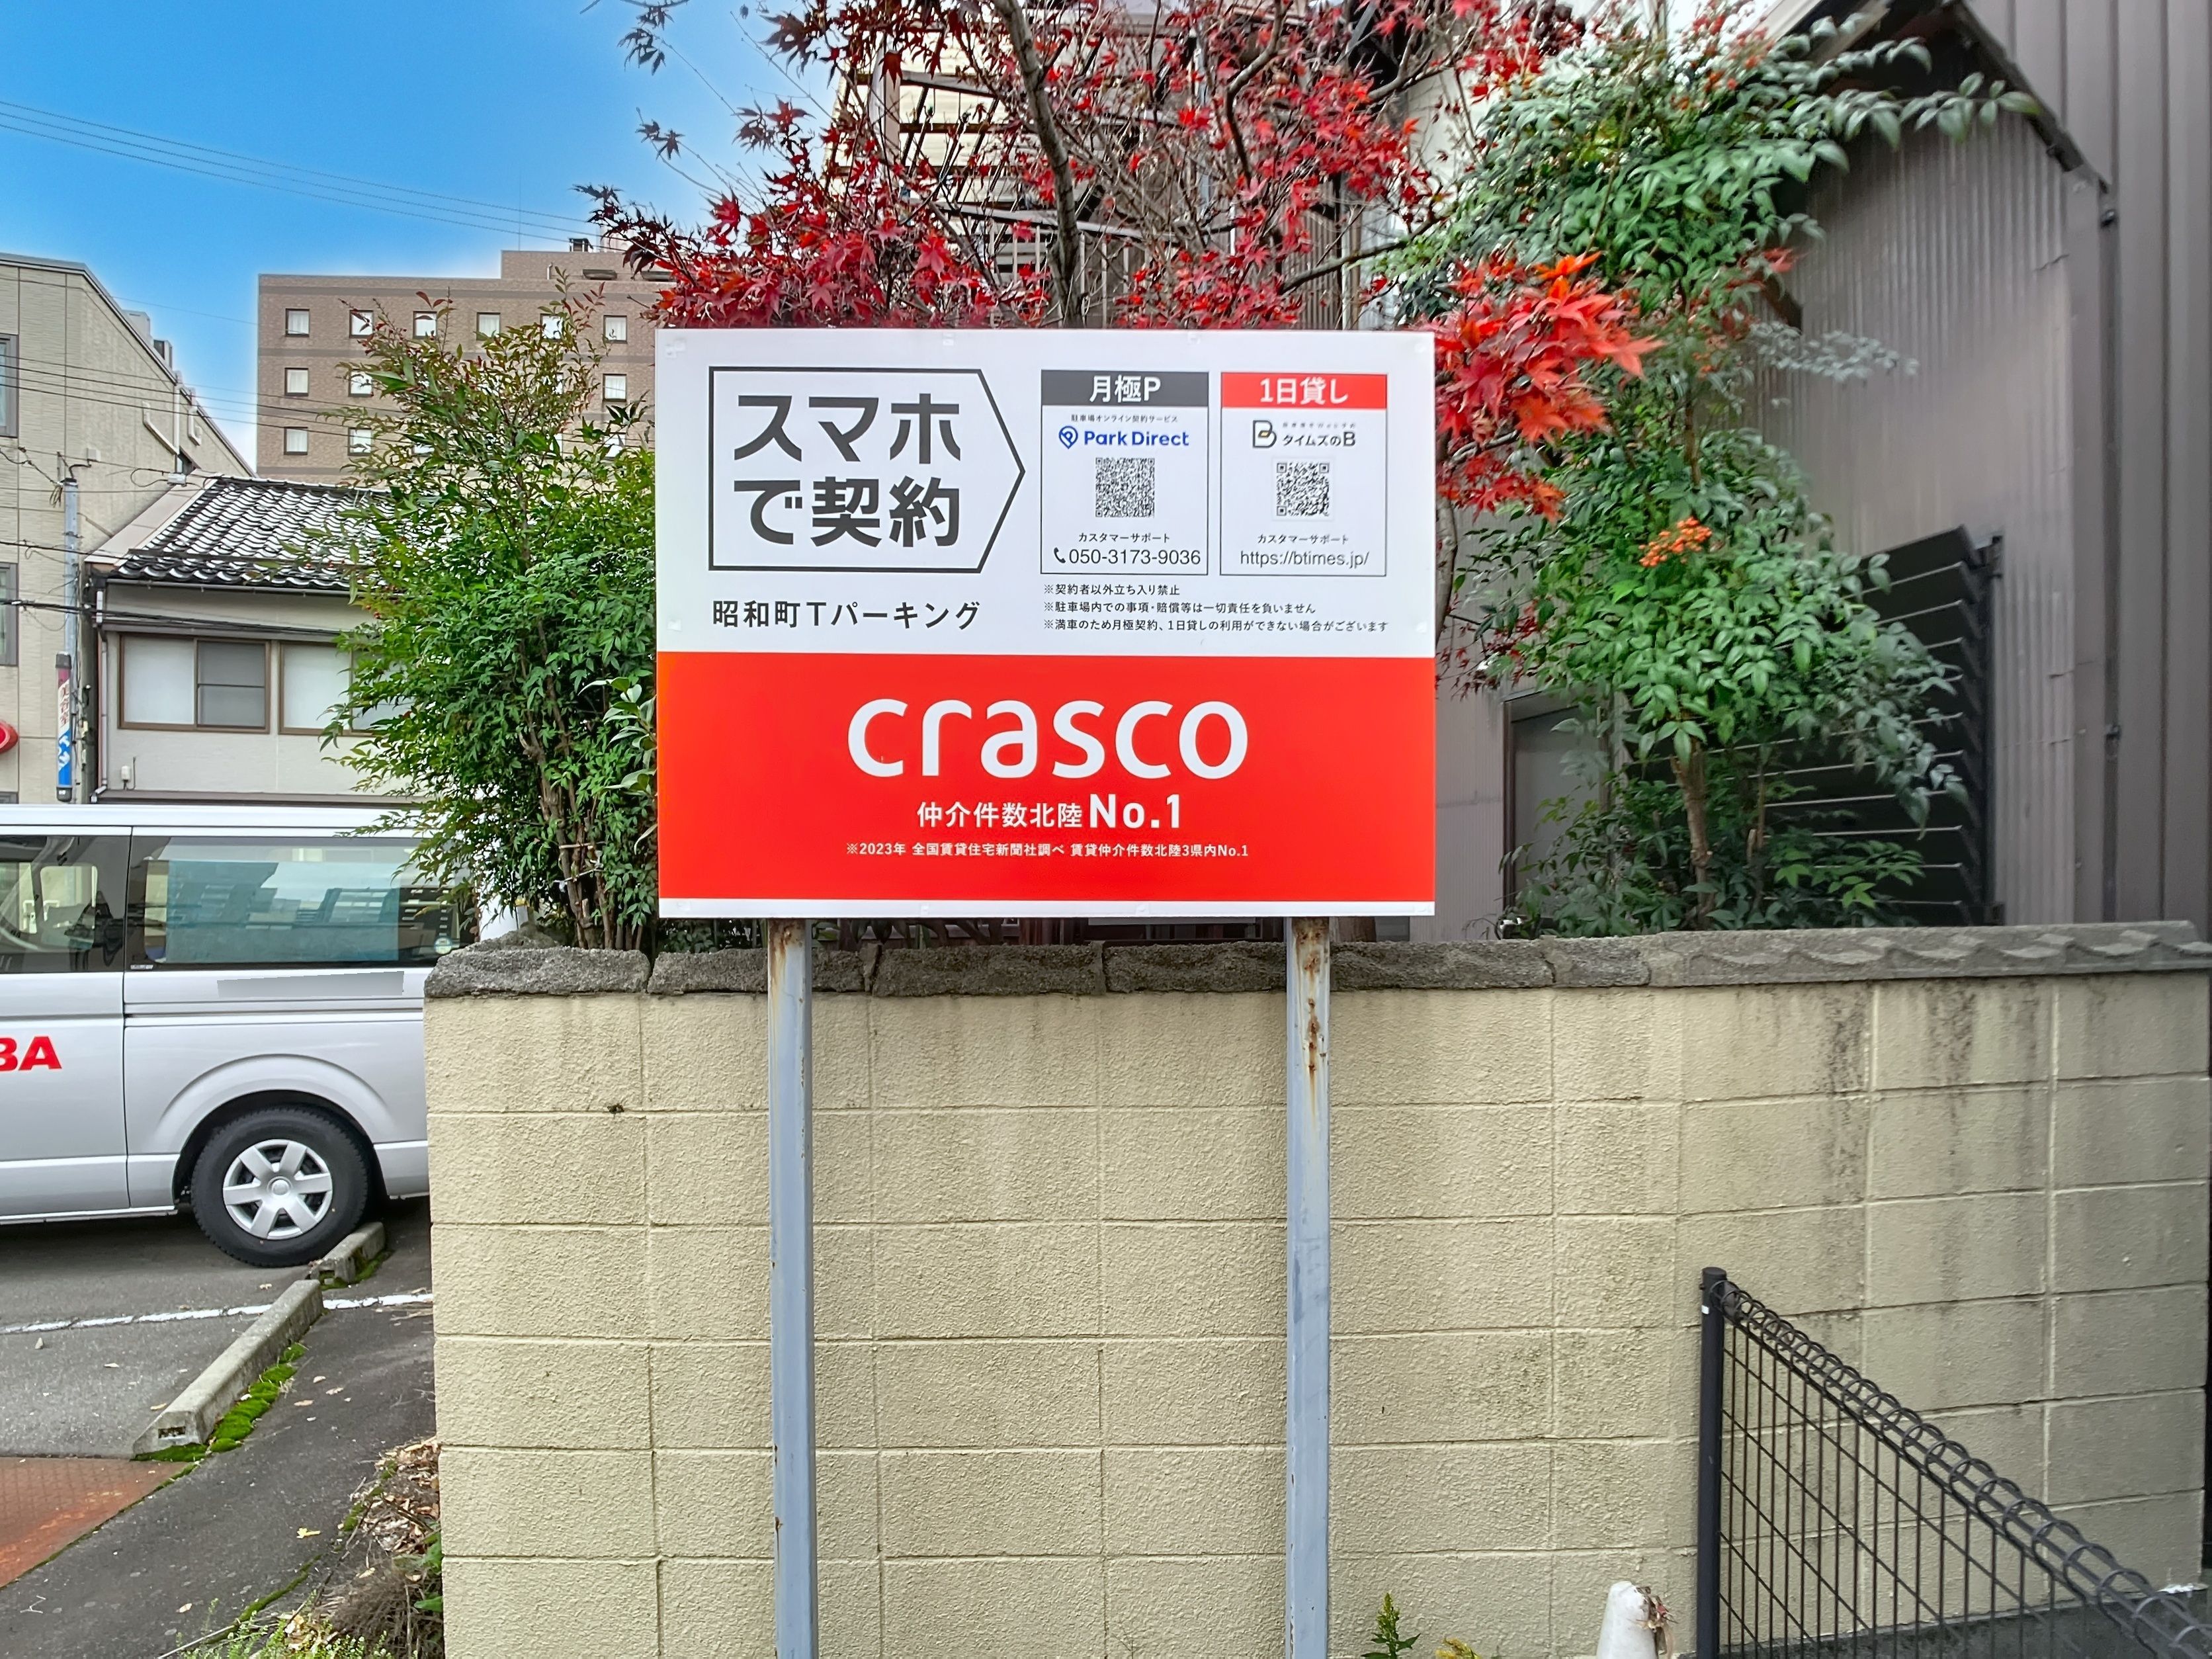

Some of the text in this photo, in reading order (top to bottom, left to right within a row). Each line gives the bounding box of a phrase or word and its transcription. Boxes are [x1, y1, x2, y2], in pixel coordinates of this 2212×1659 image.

[1089, 374, 1161, 403] 月極P
[1260, 376, 1349, 405] 1日貸し
[734, 393, 961, 464] スマホ
[1084, 431, 1189, 447] Park Direct
[1283, 431, 1356, 447] タイムズのB
[734, 475, 960, 548] で契約
[1078, 532, 1170, 543] カスタマーサポート
[1257, 534, 1349, 544] カスタマーサポート
[1069, 548, 1201, 565] 050-3173-9036
[1240, 550, 1370, 569] https://btimes.jp/
[1044, 583, 1180, 595] ※契約者以外立ち入り禁止
[712, 600, 980, 630] 昭和町Tパーキング
[847, 698, 1248, 779] crasco
[846, 842, 907, 856] ※2023年
